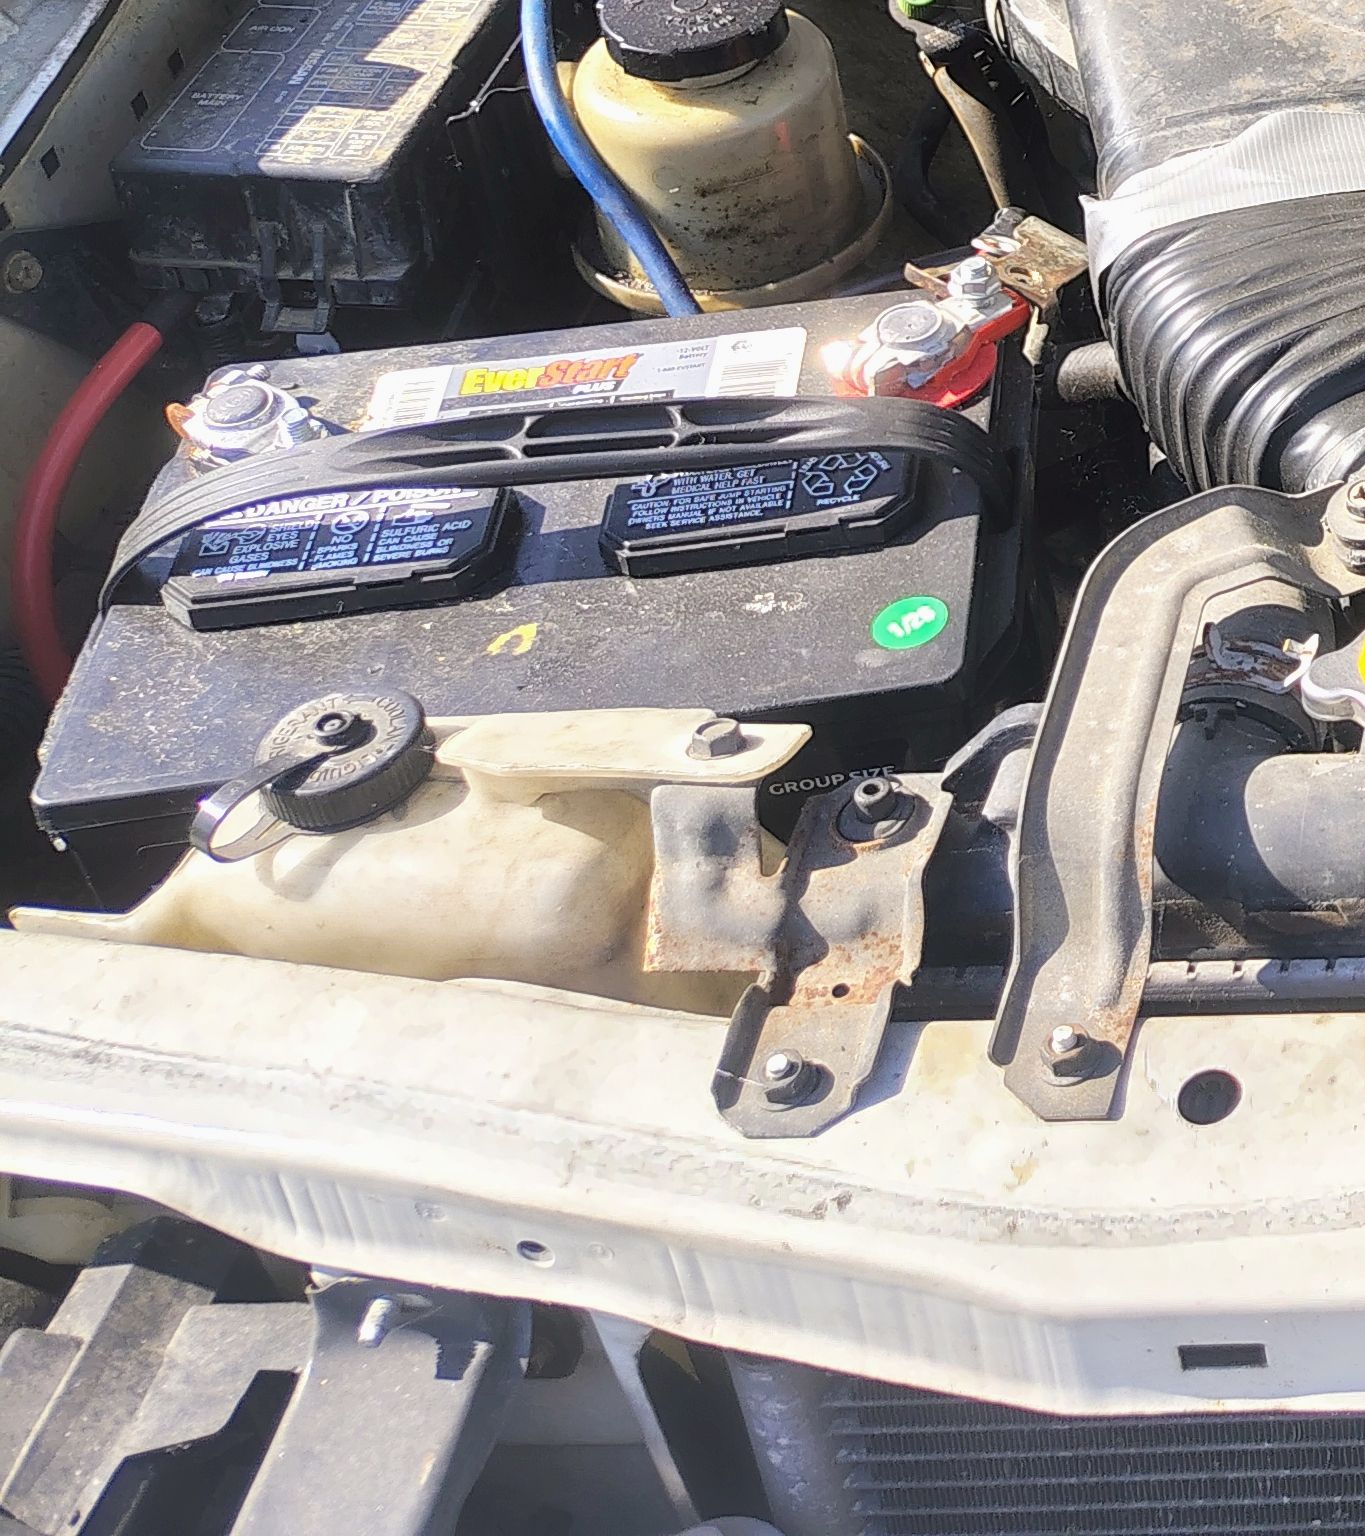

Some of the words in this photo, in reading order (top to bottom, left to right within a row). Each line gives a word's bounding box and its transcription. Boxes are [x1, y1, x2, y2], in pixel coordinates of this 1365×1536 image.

[249, 24, 270, 33] AIR
[271, 25, 296, 34] CON
[288, 48, 326, 86] NISSAN
[190, 92, 244, 101] BATTERY
[197, 99, 228, 107] MAIN
[459, 352, 643, 396] EverStart
[572, 381, 616, 395] PLUS
[672, 476, 699, 486] WITH
[736, 468, 757, 479] GET
[671, 483, 712, 495] MEDICAL
[713, 478, 740, 490] HELP
[740, 475, 766, 486] FAST
[673, 496, 692, 506] FOR
[693, 493, 716, 503] SAFE
[718, 491, 742, 501] JUMP
[743, 484, 787, 497] STARTING
[816, 494, 861, 507] RECYCLE
[632, 506, 667, 517] FOLLOW
[670, 499, 733, 513] INSTRUCTIONS
[735, 497, 745, 505] IN
[746, 492, 782, 503] VEHICLE
[718, 505, 738, 514] NOT
[738, 499, 785, 512] AVAILABLE
[268, 520, 315, 533] SHIELD
[381, 523, 441, 538] SULFURIC
[441, 519, 473, 532] ACID
[645, 521, 668, 530] SEEK
[669, 516, 706, 528] SERVICE
[266, 530, 299, 542] EYES
[330, 535, 353, 545] NO
[377, 536, 399, 546] CAN
[402, 532, 439, 543] CAUSE
[232, 539, 300, 555] EXPLOSIVE
[316, 542, 359, 554] SPARKS
[375, 540, 435, 554] BLINDNESS
[436, 537, 454, 547] OR
[228, 551, 270, 564] GASES
[313, 550, 355, 562] FLAMES
[372, 551, 413, 563] SEVERE
[414, 546, 450, 558] BURNS
[191, 567, 213, 577] CAN
[214, 565, 246, 575] CAUSE
[246, 558, 298, 571] BLINDNESS
[311, 557, 359, 571] SMOKING
[768, 772, 846, 796] GROUP
